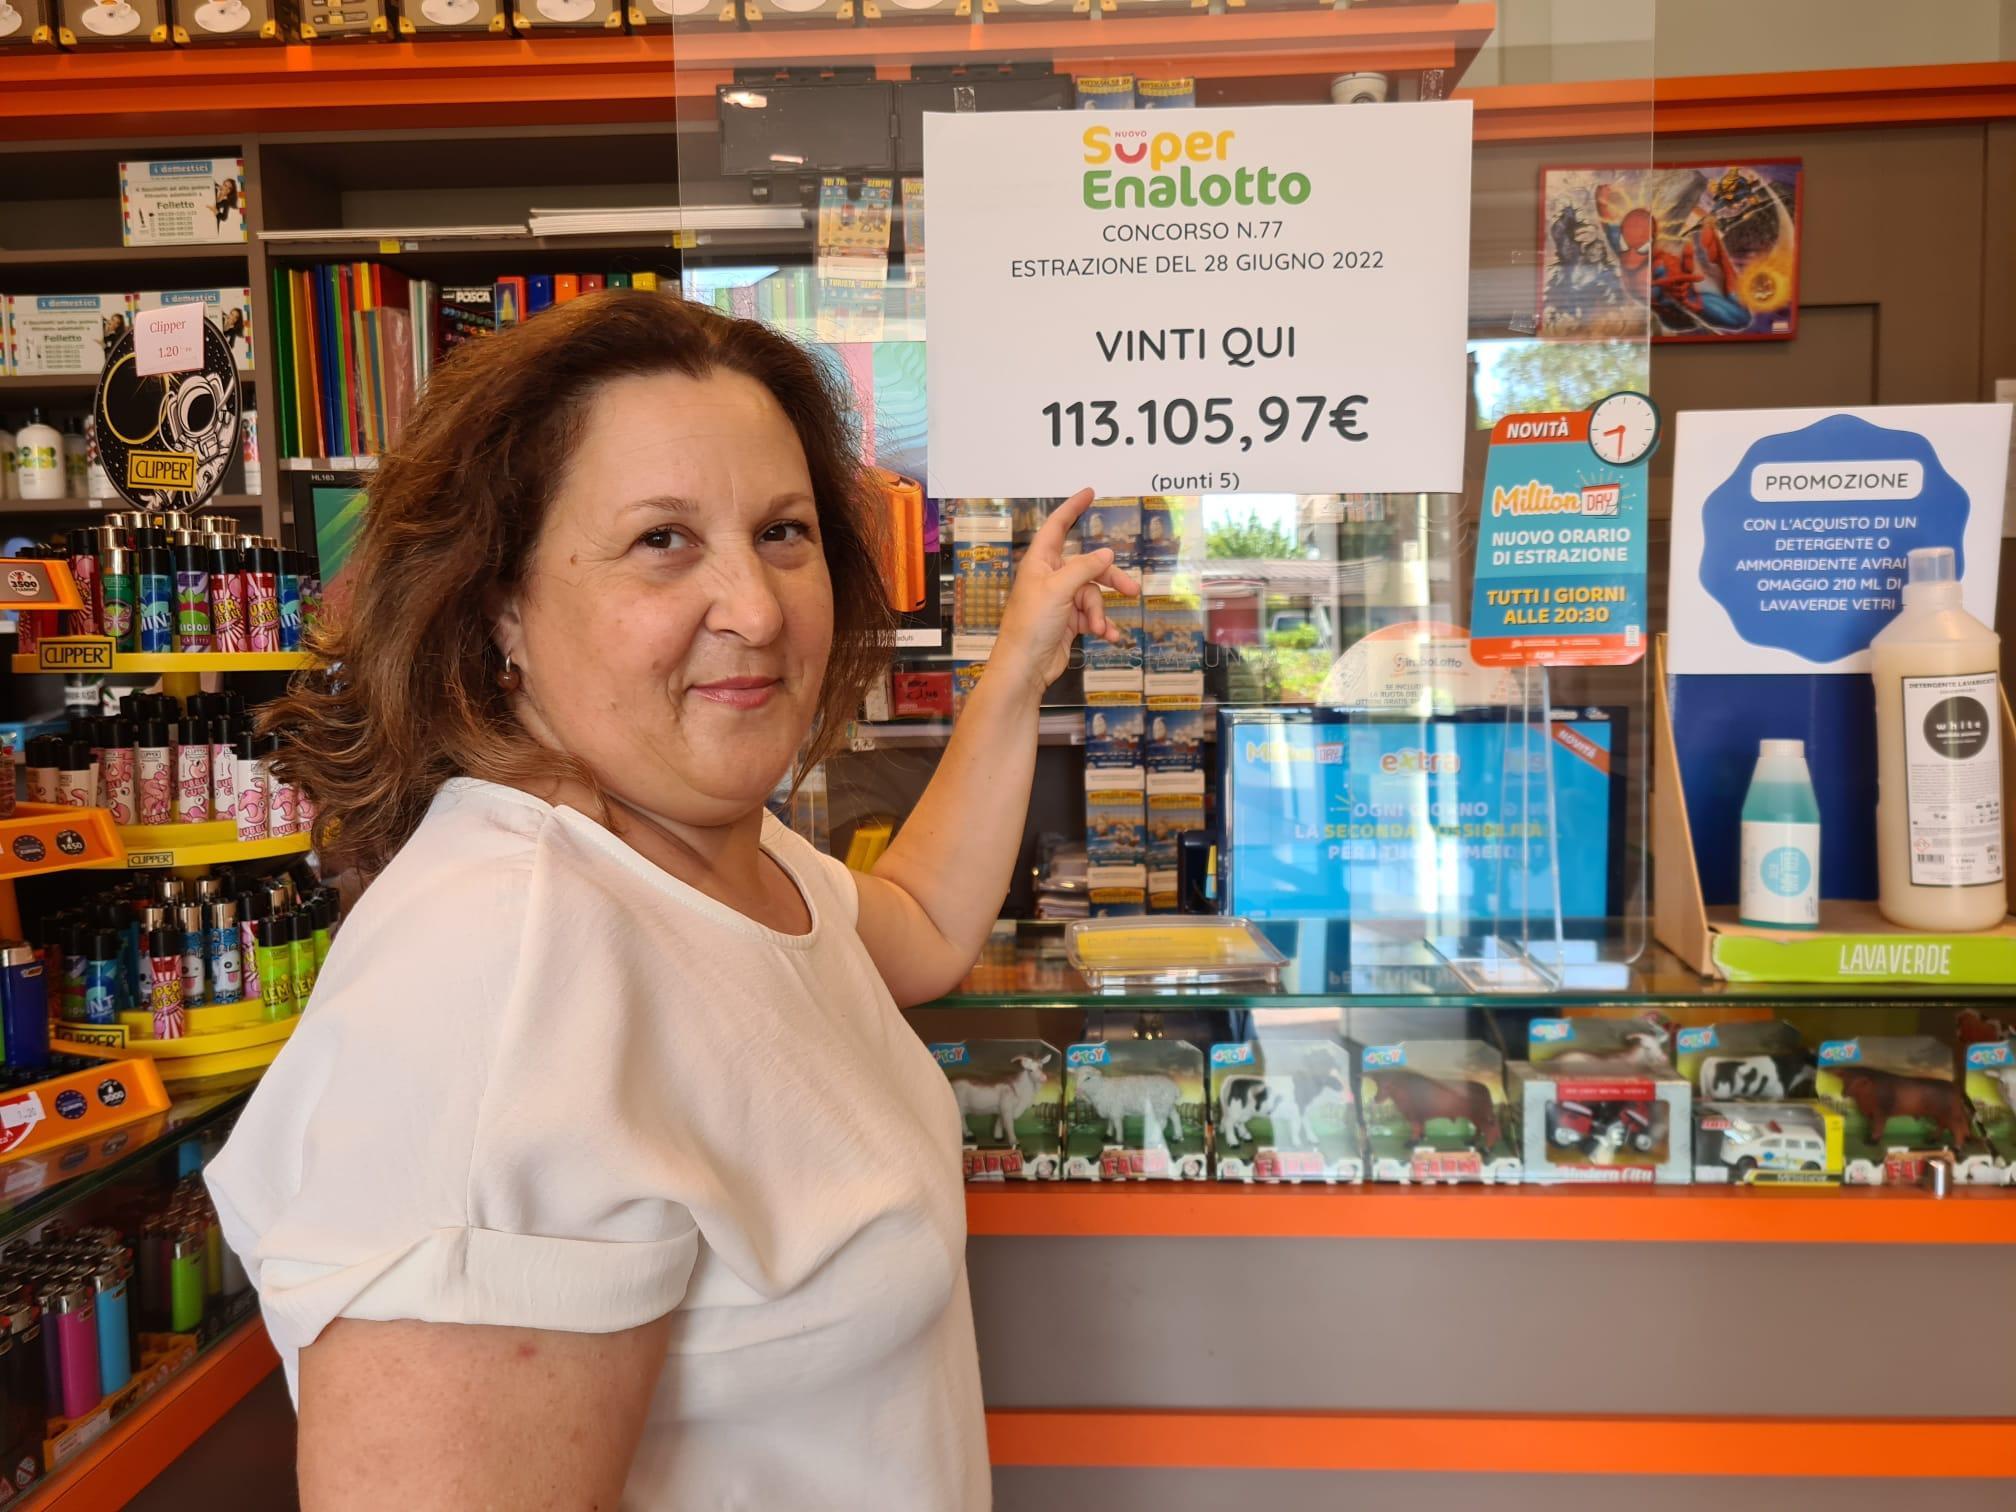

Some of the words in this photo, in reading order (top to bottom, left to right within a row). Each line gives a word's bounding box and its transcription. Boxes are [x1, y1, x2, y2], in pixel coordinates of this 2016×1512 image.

[1114, 130, 1147, 138] NUOVO
[1082, 126, 1235, 171] Super
[1082, 166, 1312, 210] Enalotto
[1102, 222, 1230, 244] CONCORSO
[1236, 220, 1284, 242] N.77
[1010, 255, 1149, 279] ESTRAZIONE
[1155, 254, 1197, 275] DEL
[1203, 254, 1229, 274] 28
[1235, 250, 1326, 273] GIUGNO
[1331, 250, 1384, 271] 2022
[455, 290, 491, 303] POSCA
[149, 321, 187, 334] Clipper
[159, 345, 180, 359] 1.20
[1095, 327, 1207, 364] VINTI
[1221, 325, 1297, 369] QUI
[1042, 394, 1370, 453] 113.105,97€
[1507, 416, 1569, 440] NOVITÀ
[135, 460, 188, 481] CLIPPER
[1150, 472, 1214, 494] (punti
[1218, 471, 1240, 493] 5)
[1765, 472, 1910, 491] PROMOZIONE
[1492, 480, 1582, 518] Million
[1585, 490, 1615, 514] DAY
[1743, 517, 1776, 532] CON
[1779, 516, 1871, 533] L'ACQUISTO
[1873, 516, 1891, 530] DI
[1894, 515, 1918, 530] UN
[1491, 528, 1555, 548] NUOVO
[1557, 526, 1632, 546] ORARIO
[1774, 537, 1873, 553] DETERGENTE
[1876, 536, 1891, 551] O
[1492, 549, 1511, 567] DI
[1513, 546, 1629, 566] ESTRAZIONE
[1735, 558, 1857, 573] AMMORBIDENTE
[1859, 556, 1908, 571] AVRAI
[1756, 578, 1830, 593] OMAGGIO
[1832, 578, 1857, 592] 210
[1860, 577, 1882, 592] ML
[1885, 577, 1902, 591] DI
[1486, 589, 1540, 607] TUTTI
[1542, 587, 1551, 604] I
[1553, 585, 1627, 604] GIORNI
[1759, 598, 1848, 613] LAVAVERDE
[1851, 597, 1896, 612] VETRI
[1502, 606, 1551, 626] ALLE
[1552, 605, 1611, 625] 20:30
[44, 646, 105, 664] CLIPPER
[130, 854, 171, 865] CLIPPER
[1839, 943, 1952, 976] LAVAVERDE
